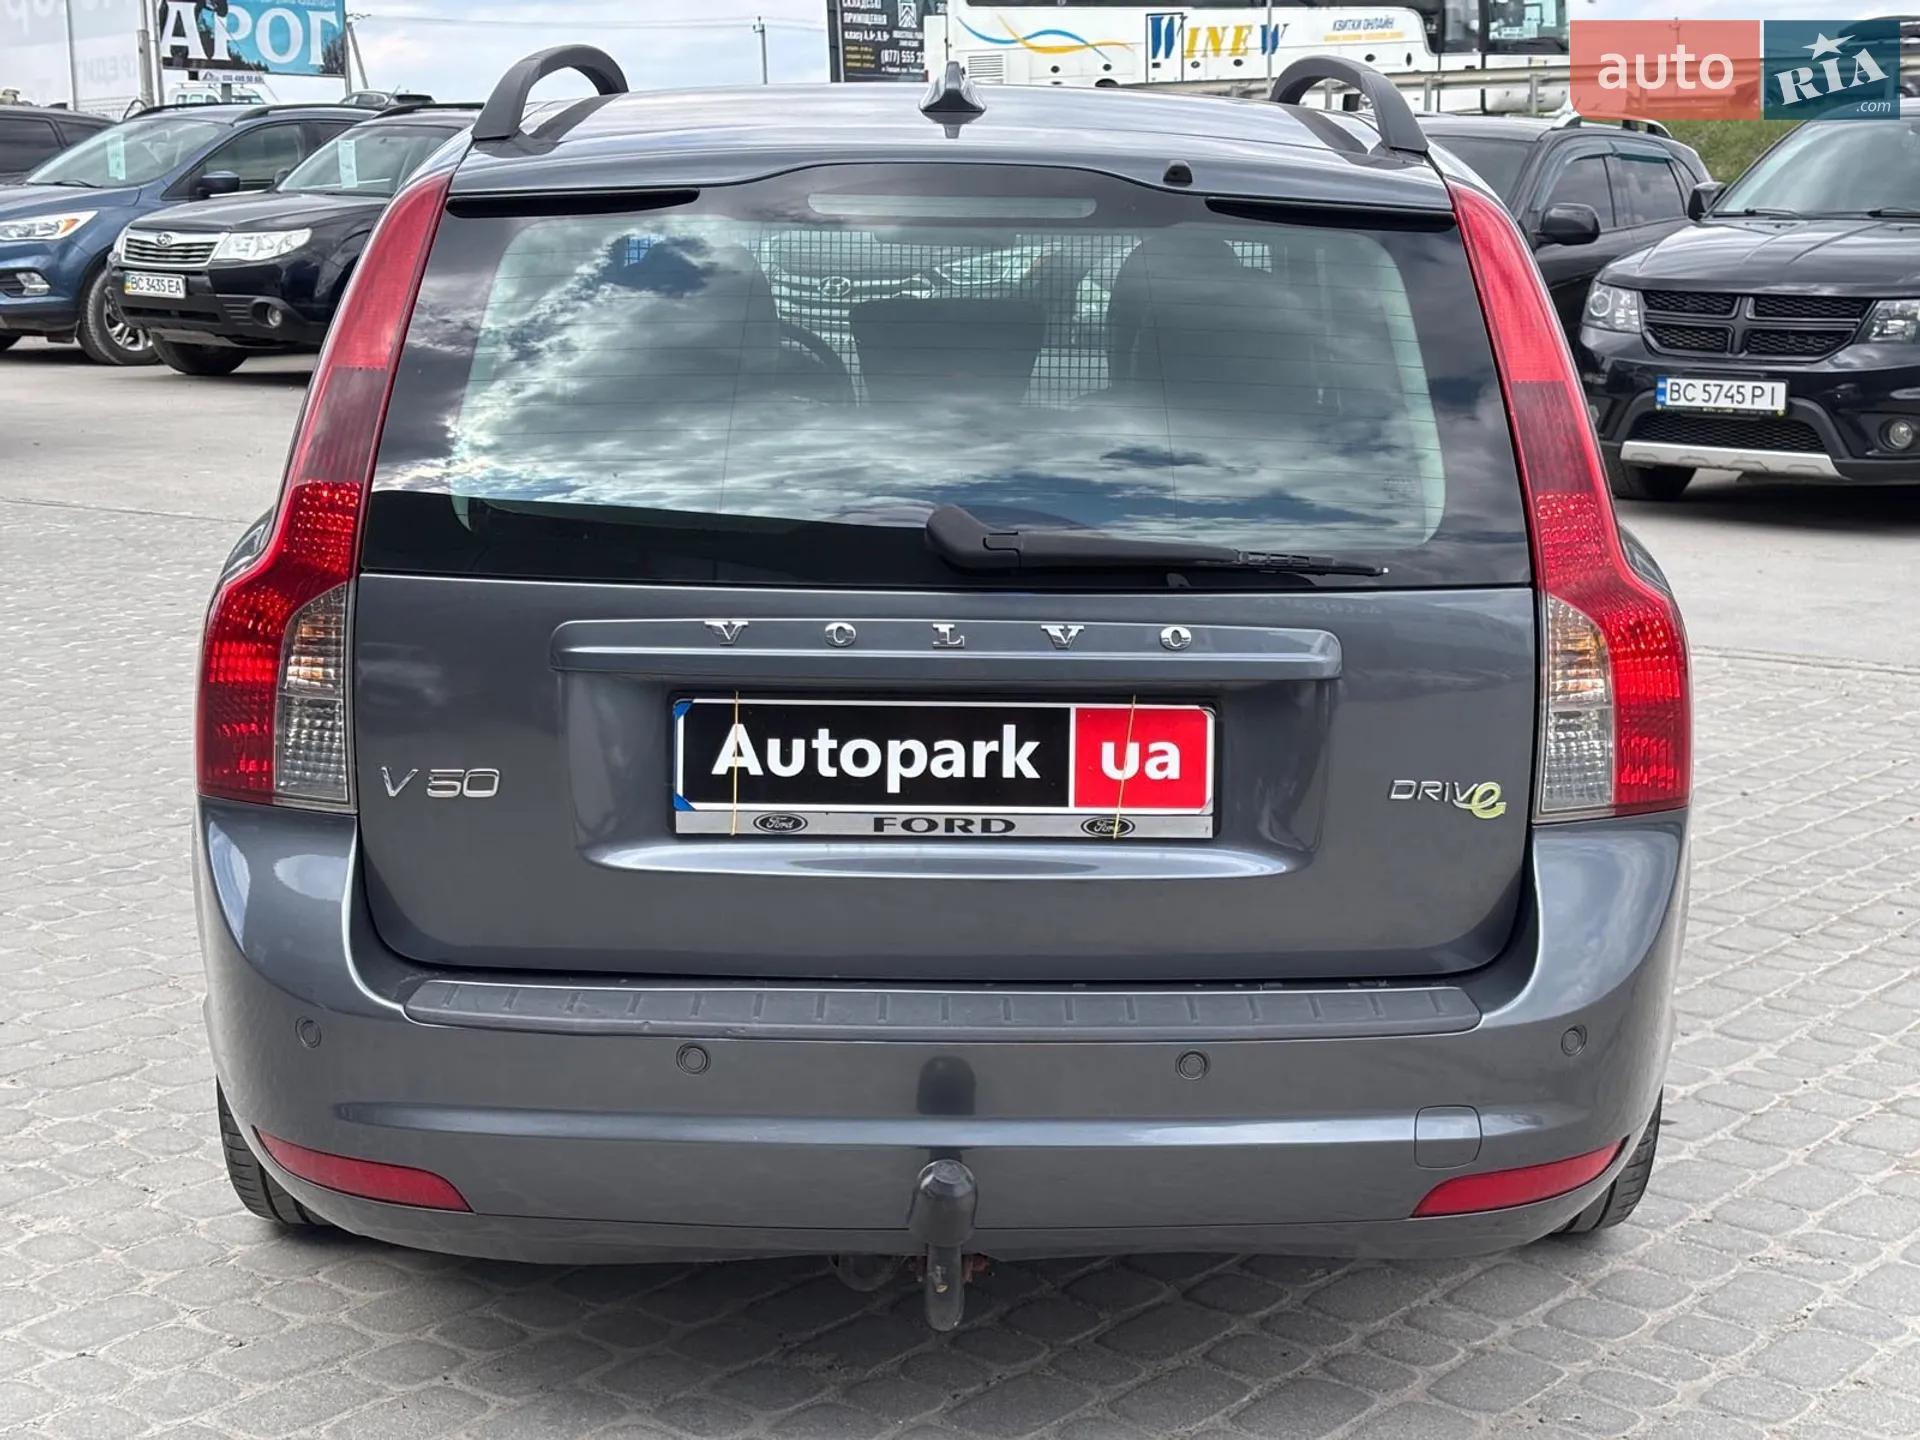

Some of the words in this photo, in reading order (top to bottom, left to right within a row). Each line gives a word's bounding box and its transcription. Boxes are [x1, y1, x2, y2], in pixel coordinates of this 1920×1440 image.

[131, 277, 144, 291] BC
[145, 278, 166, 292] 3435
[168, 280, 182, 294] EA
[1669, 382, 1697, 402] BC
[1702, 383, 1746, 404] 5745
[704, 620, 1192, 650] VOLVO
[711, 723, 1041, 794] Autopark
[1101, 741, 1181, 781] ua
[873, 817, 1016, 834] FORD
